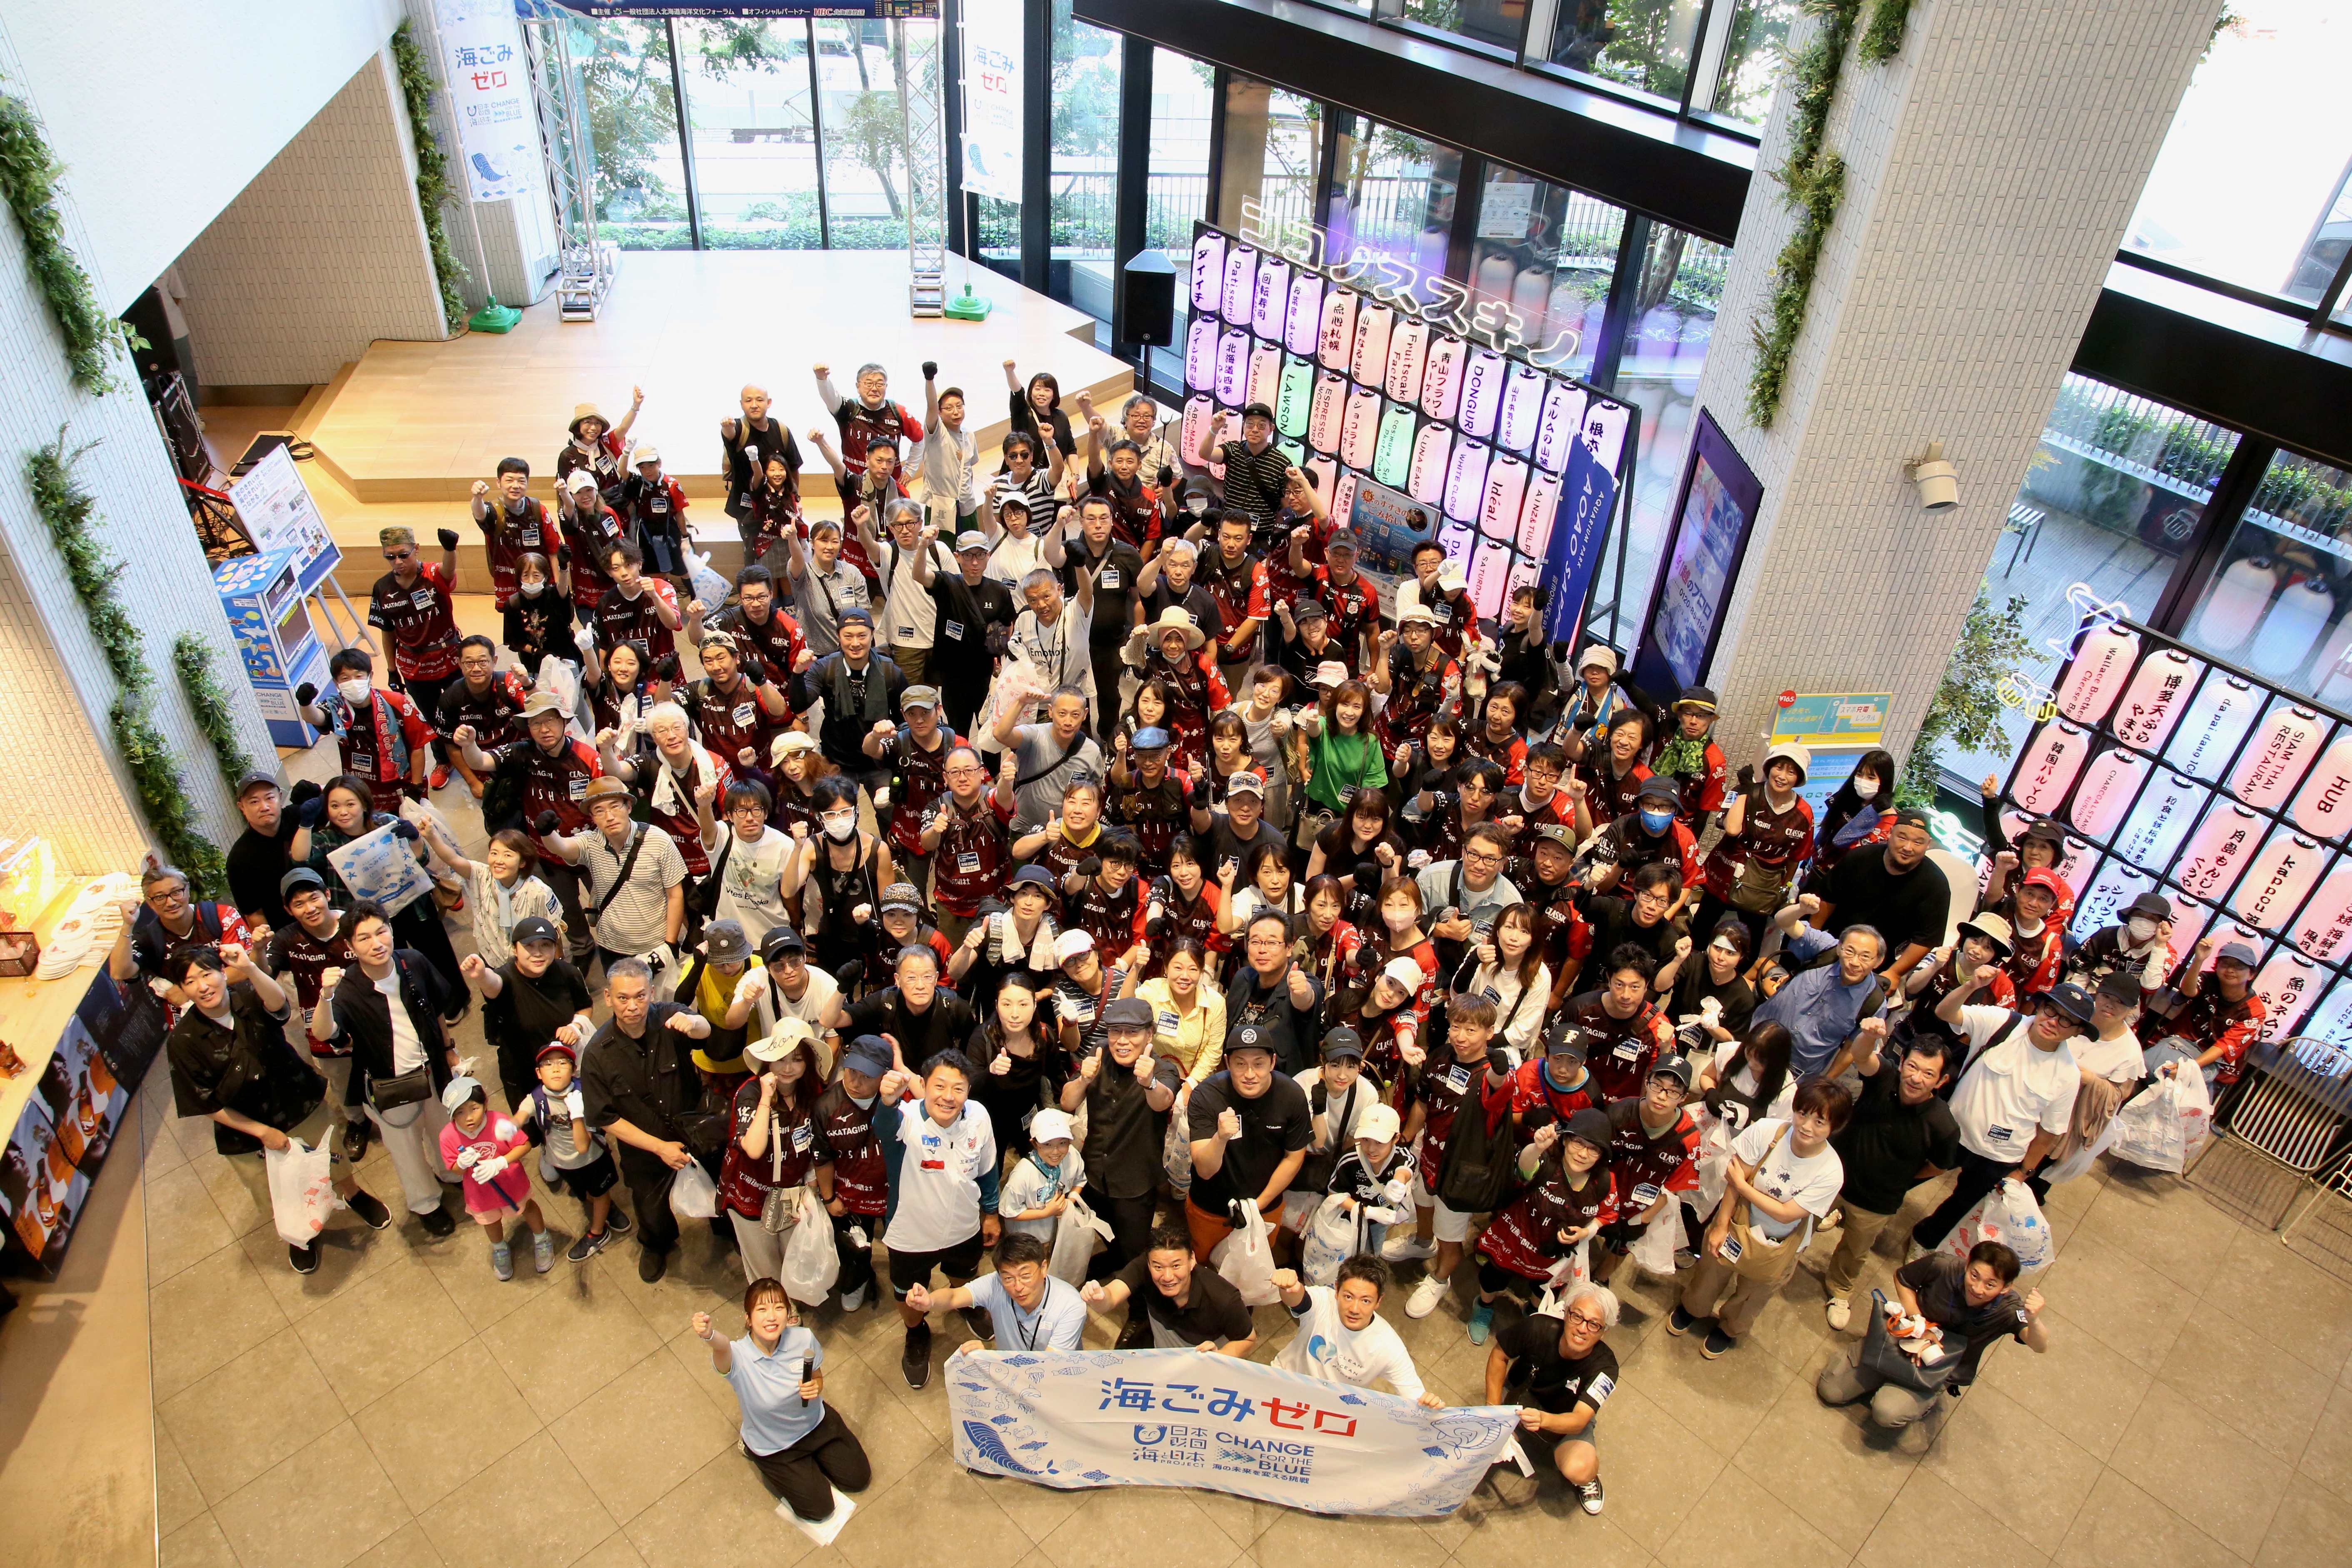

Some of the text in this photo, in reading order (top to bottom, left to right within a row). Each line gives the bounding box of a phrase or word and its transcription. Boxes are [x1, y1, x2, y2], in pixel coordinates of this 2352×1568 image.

[455, 43, 514, 69] 海ごみ
[973, 44, 1015, 74] 海ごみ
[471, 71, 507, 91] ゼロ
[981, 72, 1008, 95] ゼロ
[491, 98, 520, 108] CHANGE
[1194, 249, 1210, 302] ダイイチ
[1227, 260, 1242, 323] Patisserie
[1238, 201, 1581, 370] ココノススキノ
[1328, 303, 1345, 351] 点心札幌
[1222, 342, 1237, 394] 北海道四季
[1399, 334, 1417, 401] Fruitscake
[1433, 352, 1452, 417] 青山フラワー
[1185, 404, 1193, 432] GRAND
[1280, 374, 1295, 432] LAWSON
[1317, 388, 1332, 439] ESPRESSO
[1464, 365, 1485, 433] DONGURI
[1505, 385, 1519, 446] 山下本気うどん
[1186, 406, 1199, 454] ABC-MART
[1347, 400, 1362, 465] ショコラティエ
[1419, 435, 1430, 463] LUNA
[1447, 453, 1467, 519] WHITE CLOSET
[1359, 512, 1374, 524] 8.24
[1368, 504, 1402, 526] ごみ拾い
[1523, 489, 1544, 556] AINZ&TULPE
[1570, 472, 1593, 557] AOAO
[1577, 490, 1604, 569] AQUARIUM PARK
[1342, 592, 1367, 602] あいプラン
[1474, 554, 1489, 607] SATURDAYS
[384, 599, 409, 609] KATAGIRI
[607, 611, 634, 621] KATAGIRI
[2094, 648, 2118, 684] Wallace
[2072, 671, 2093, 701] Cheese
[2119, 703, 2144, 741] やまや
[2135, 673, 2182, 743] 博多天ぷら
[2184, 698, 2231, 776] da pai dang 105
[2239, 724, 2292, 802] RESTAURANT
[2261, 729, 2305, 790] SIAM THAI
[2317, 775, 2351, 814] HUB
[1785, 828, 1806, 839] CLASSIC
[2143, 795, 2177, 846] 和食と鉄板焼
[2181, 857, 2205, 887] くうや
[2195, 828, 2246, 897] 月島もんじゃ
[2254, 854, 2295, 913] kappou
[2094, 884, 2125, 929] シリウス
[832, 1124, 869, 1137] KATAGIRI
[765, 1209, 774, 1230] BOOKS
[1339, 1354, 1363, 1368] CLEAN
[1098, 1377, 1358, 1437] 海ごみゼロ
[1170, 1425, 1208, 1437] 日本
[1170, 1437, 1207, 1450] 財団
[1215, 1432, 1315, 1458] CHANGE
[1132, 1447, 1206, 1463] 海と日本
[1160, 1460, 1205, 1468] PROJECT
[1212, 1463, 1310, 1485] 海の未来を変える挑戦
[1258, 1460, 1312, 1476] BLUE
[1260, 1453, 1313, 1467] FOR THE
